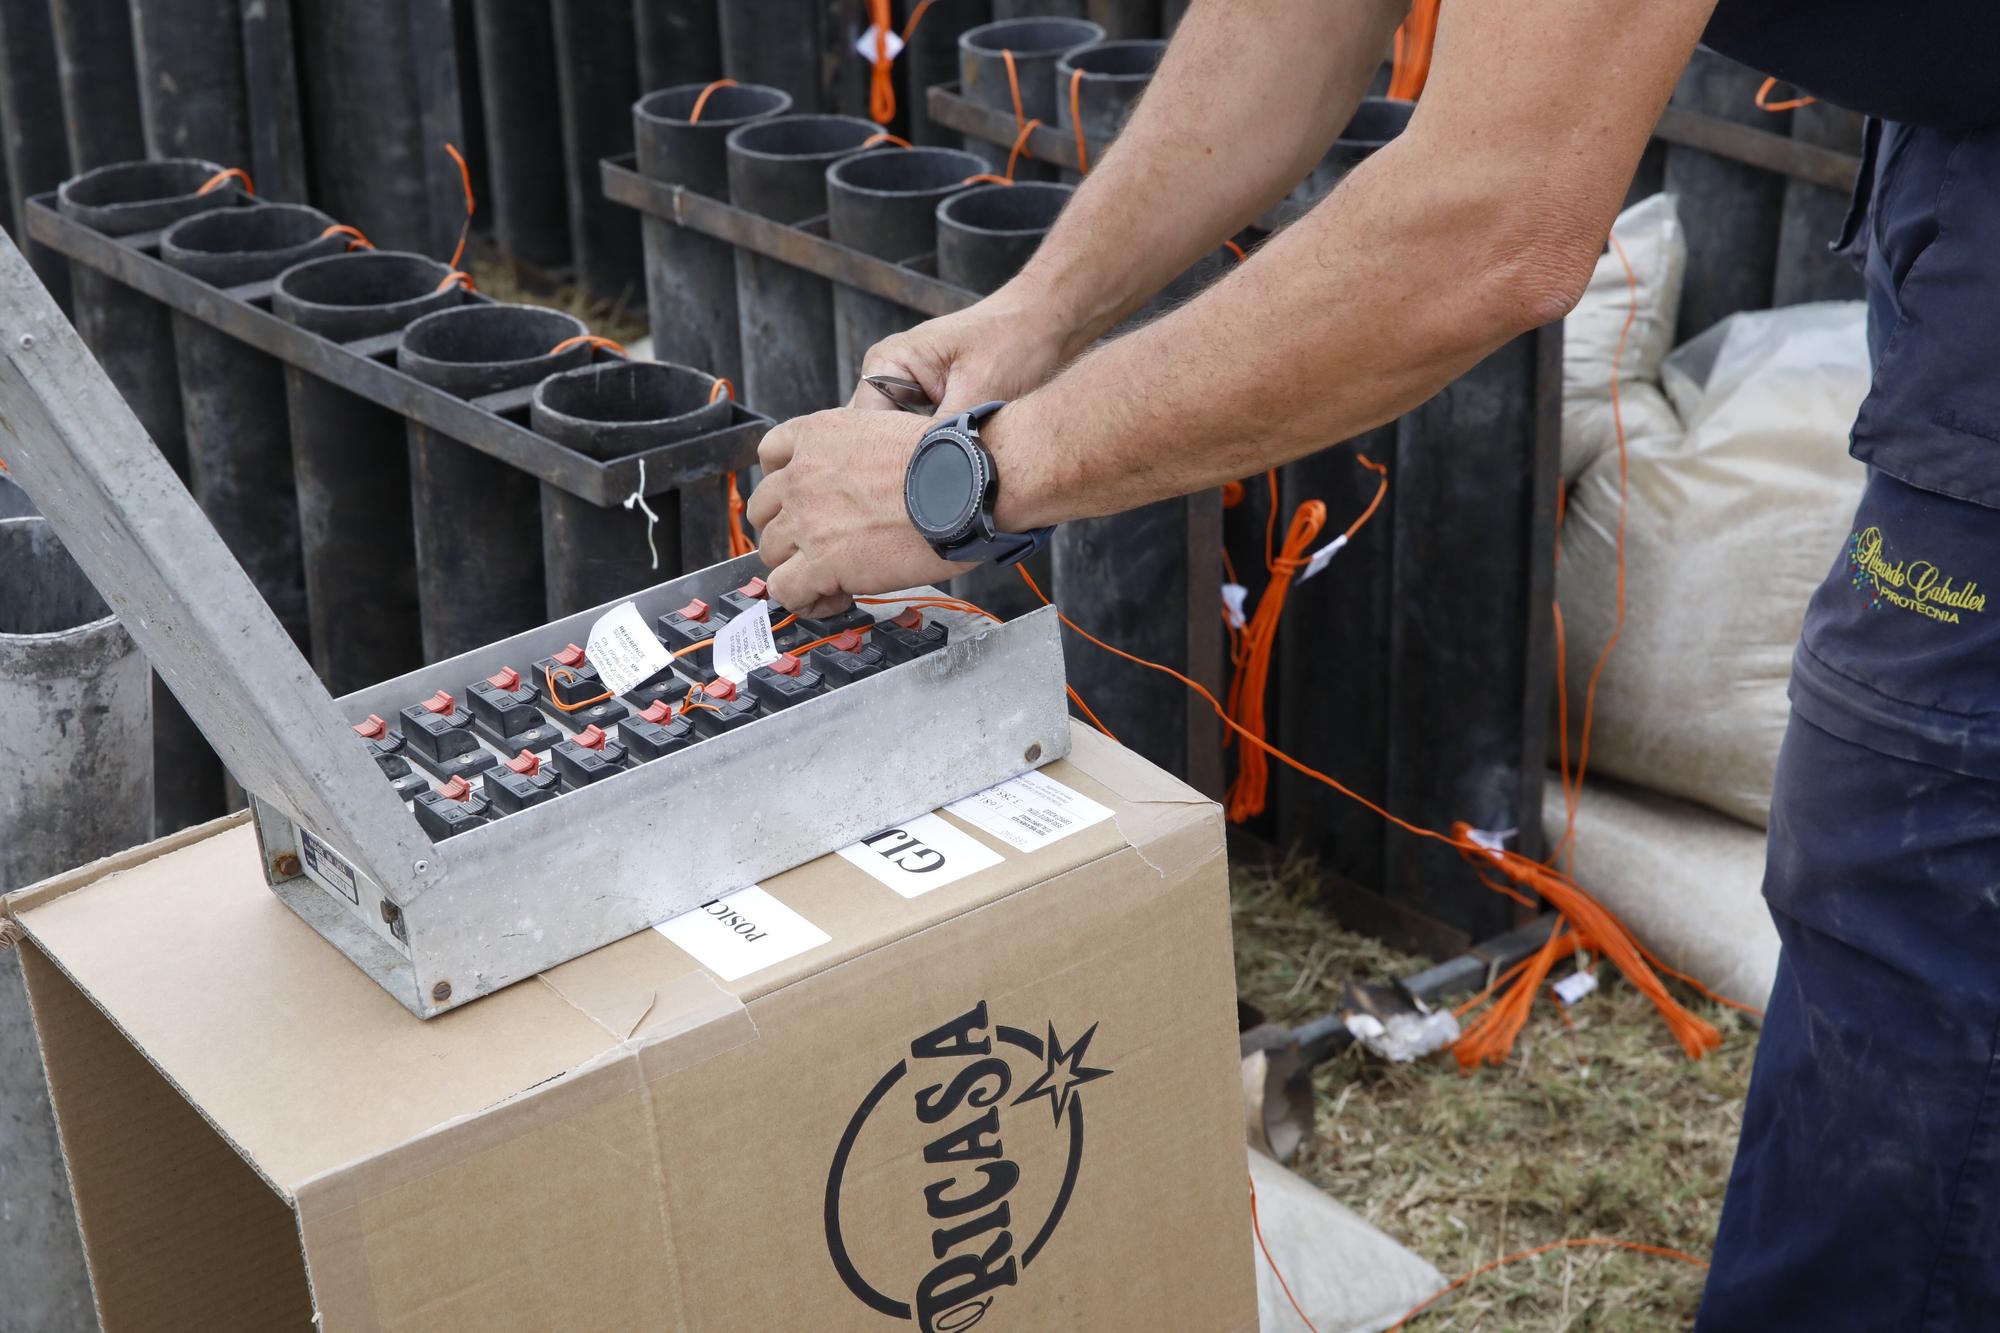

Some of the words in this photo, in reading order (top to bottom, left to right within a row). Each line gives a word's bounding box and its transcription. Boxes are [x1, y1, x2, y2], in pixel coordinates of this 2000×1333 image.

[1880, 586, 1960, 624] PIROTECNIA
[1907, 560, 1986, 612] Caballer
[619, 625, 645, 659] REFERENCE
[759, 616, 770, 650] REFERENCE
[630, 663, 640, 672] MM
[860, 829, 945, 873] GIJ
[910, 999, 1020, 1333] RICASA
